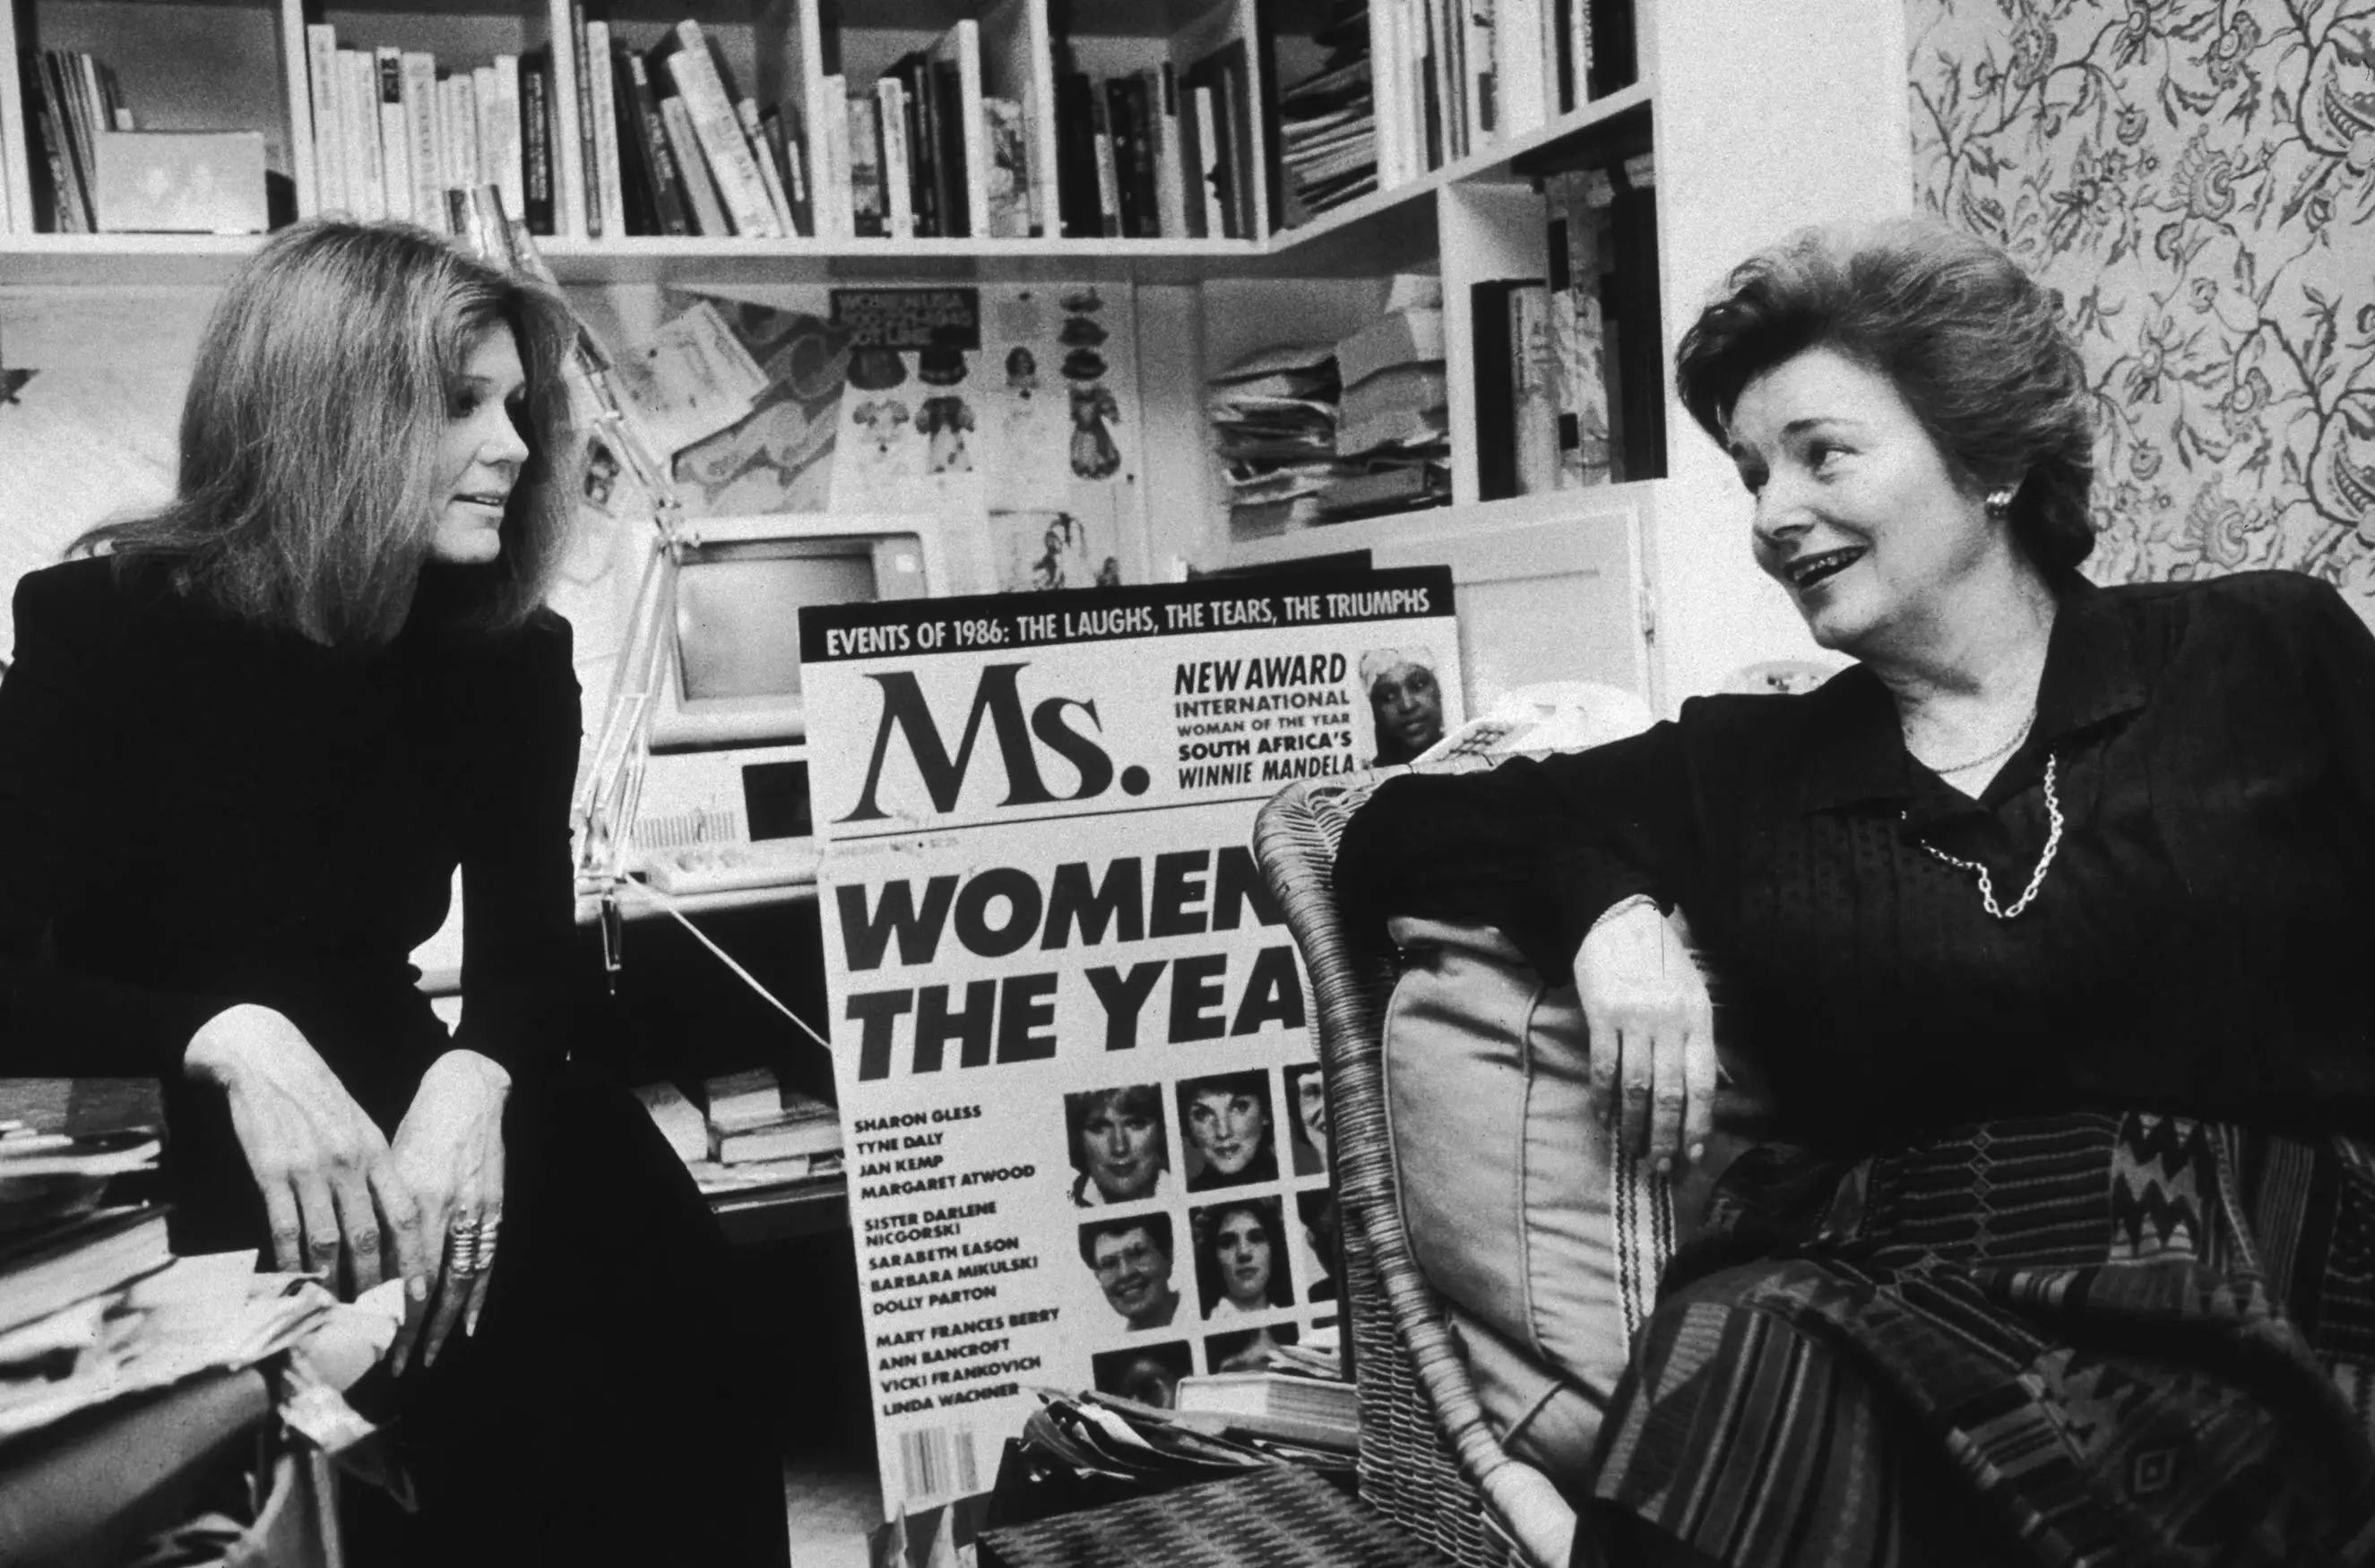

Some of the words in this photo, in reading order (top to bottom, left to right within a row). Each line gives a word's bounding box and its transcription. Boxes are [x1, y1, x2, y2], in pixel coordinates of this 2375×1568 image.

[826, 625, 911, 656] EVENTS
[917, 622, 946, 649] OF
[954, 619, 1010, 645] 1986:
[1016, 614, 1057, 642] THE
[1065, 606, 1159, 637] LAUGHS,
[1165, 603, 1205, 629] THE
[1210, 598, 1278, 627] TEARS,
[1282, 595, 1321, 621] THE
[1326, 588, 1430, 618] TRIUMPHS
[1175, 659, 1242, 696] NEW
[1244, 652, 1347, 690] AWARD
[1175, 690, 1351, 719] INTERNATIONAL
[1177, 720, 1245, 737] WOMAN
[1251, 718, 1272, 732] OF
[1277, 715, 1305, 729] THE
[1312, 712, 1351, 726] YEAR
[830, 661, 1151, 824] Ms.
[1179, 739, 1250, 762] SOUTH
[1257, 730, 1352, 754] AFRICA'S
[1179, 762, 1253, 789] WINNIE
[1262, 754, 1354, 781] MANDELA
[835, 845, 1288, 972] WOMEN
[846, 972, 1058, 1082] THE
[1084, 945, 1306, 1052] YEA
[854, 1112, 928, 1133] SHARON
[931, 1105, 982, 1124] GLESS
[857, 1138, 899, 1155] TYNE
[903, 1132, 944, 1150] DALY
[859, 1161, 891, 1177] JAN
[894, 1154, 944, 1173] KEMP
[861, 1176, 955, 1200] MARGARET
[961, 1165, 1036, 1186] ATWOOD
[865, 1213, 918, 1232] SISTER
[923, 1201, 998, 1224] DARLENE
[866, 1223, 962, 1247] NICGORSKI
[869, 1245, 958, 1271] SARABETH
[962, 1236, 1020, 1257] EASON
[871, 1270, 953, 1292] BARBARA
[957, 1255, 1039, 1279] MIKULSKI
[873, 1297, 923, 1315] DOLLY
[928, 1285, 997, 1306] PARTON
[877, 1330, 925, 1348] MARY
[930, 1316, 1005, 1340] FRANCES
[1008, 1307, 1060, 1327] BERRY
[879, 1354, 917, 1370] ANN
[921, 1338, 1010, 1364] BANCROFT
[881, 1375, 927, 1392] VICKI
[931, 1356, 1041, 1385] FRANKOVICH
[883, 1397, 934, 1417] LINDA
[938, 1383, 1019, 1407] WACHNER
